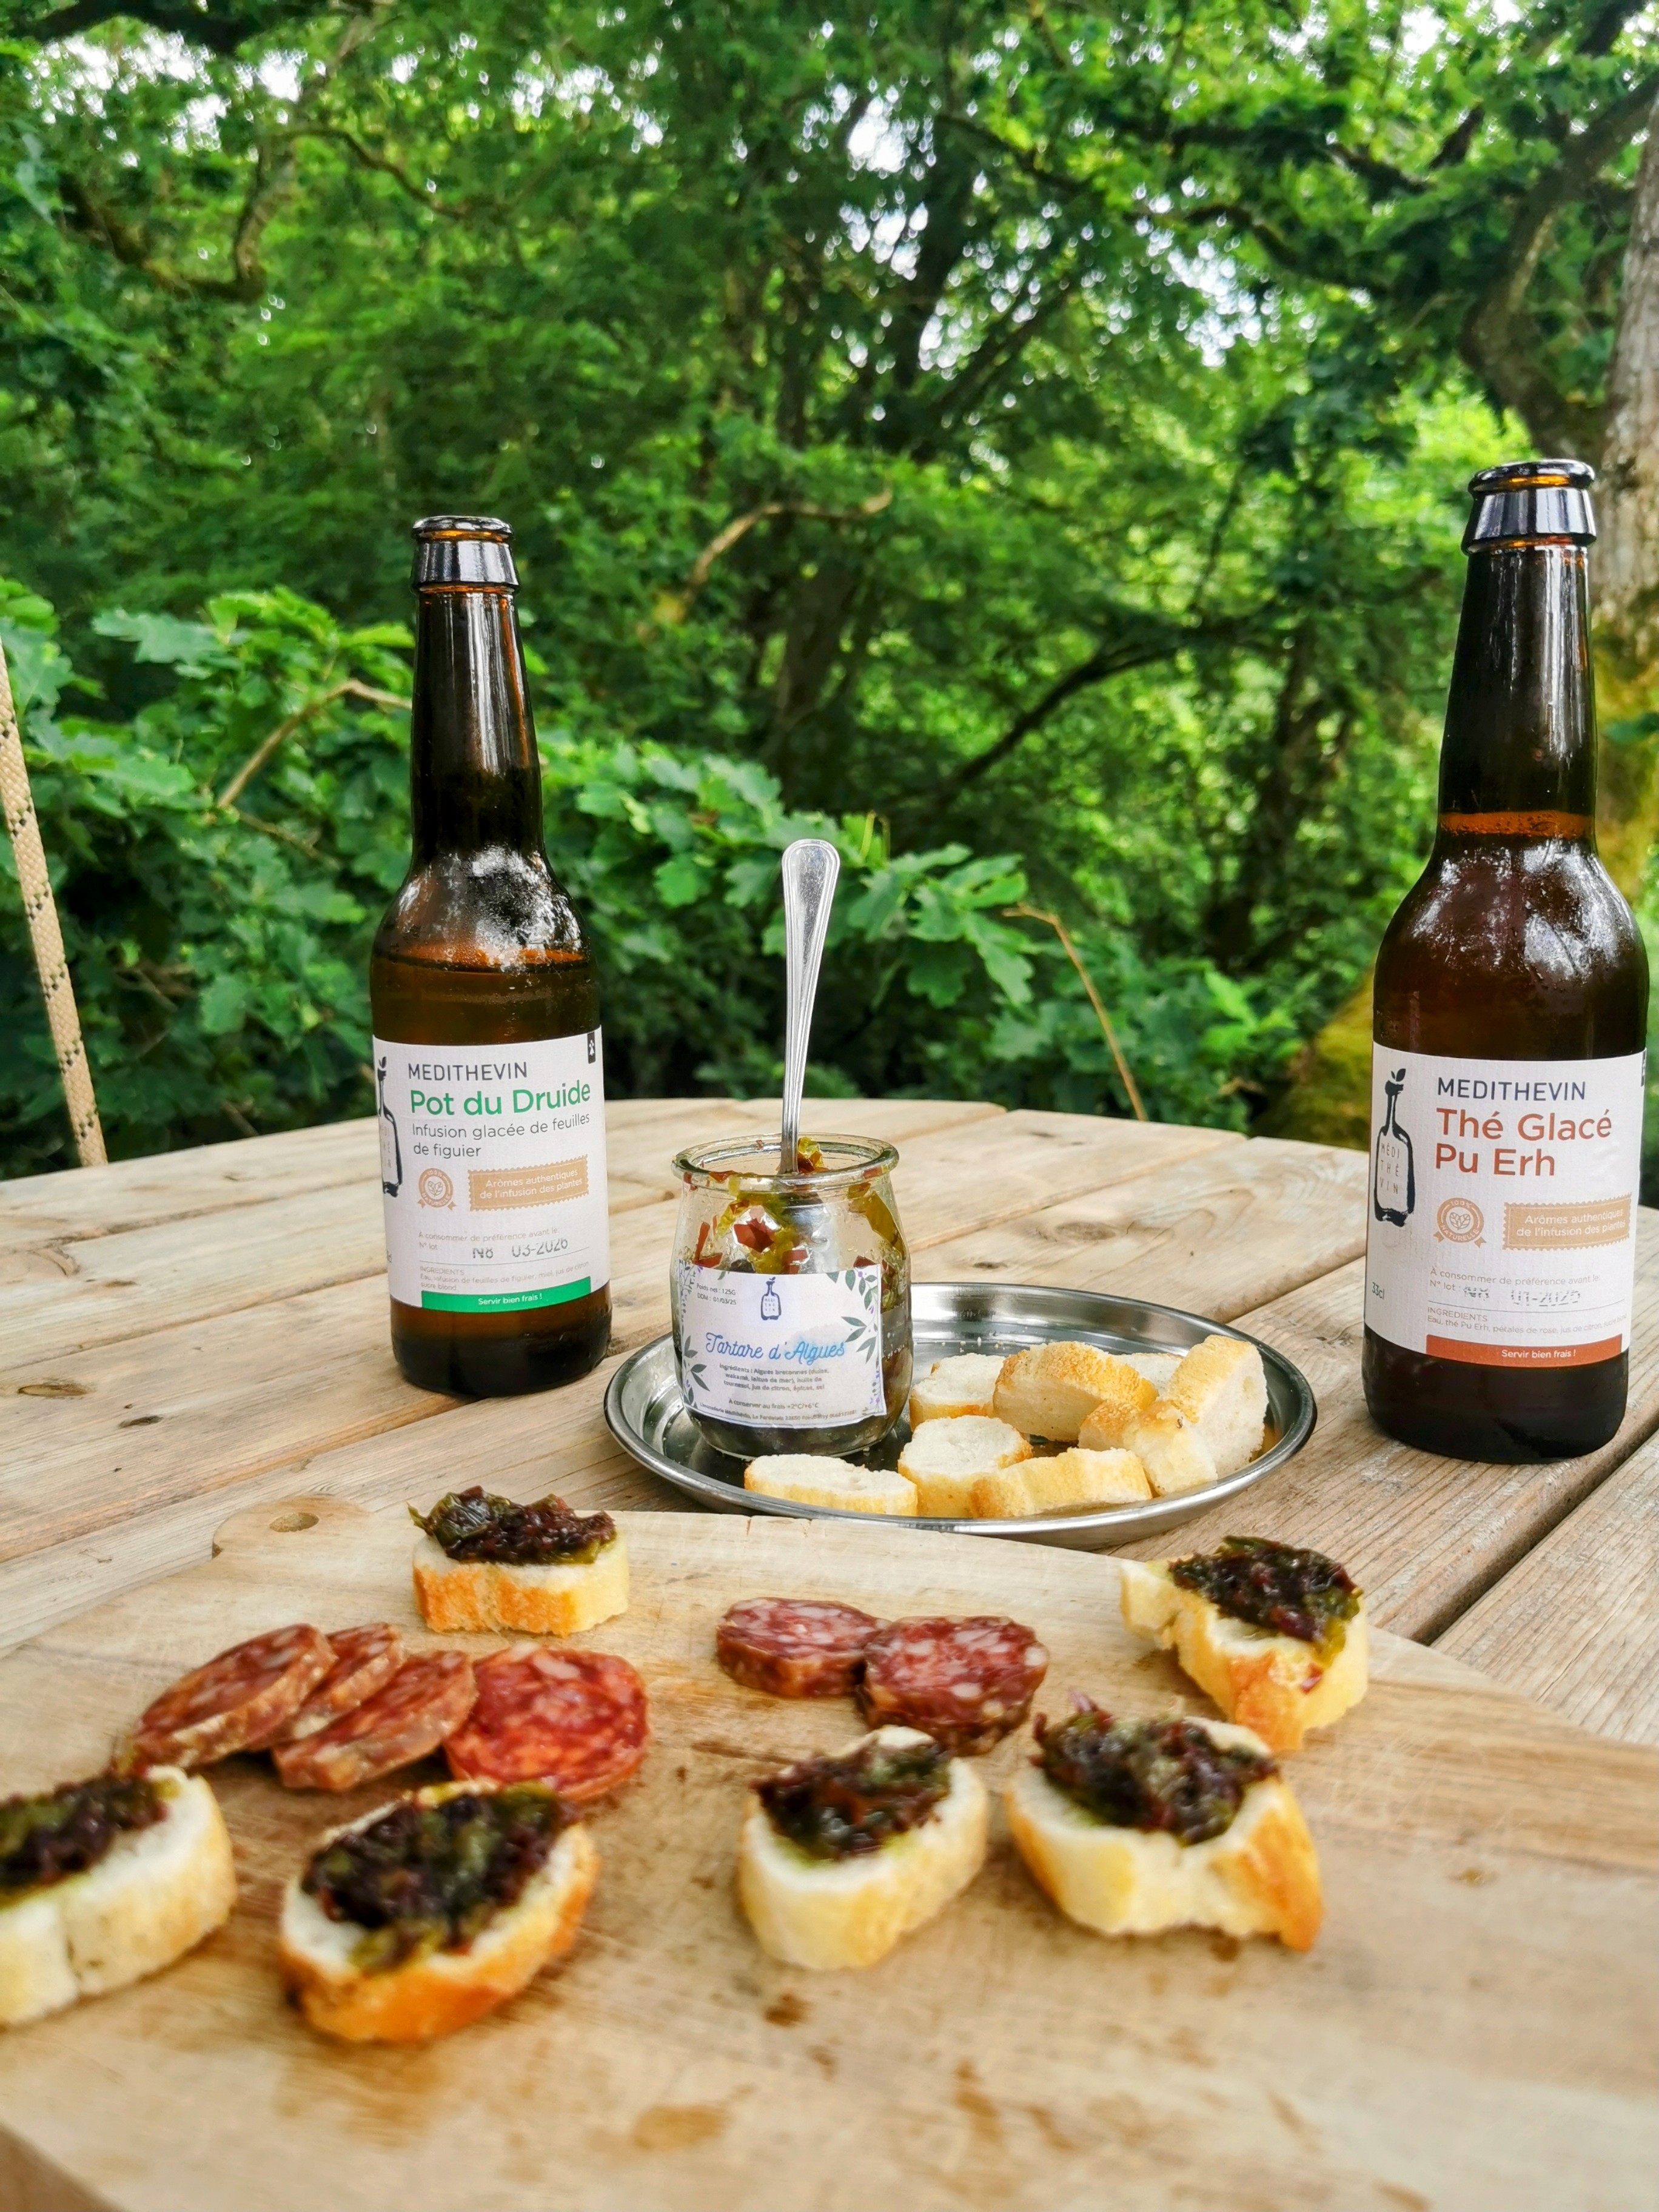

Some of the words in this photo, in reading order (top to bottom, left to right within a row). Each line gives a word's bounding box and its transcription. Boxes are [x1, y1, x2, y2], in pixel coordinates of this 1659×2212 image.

[408, 1062, 527, 1081] MEDITHEVIN
[411, 1090, 455, 1115] Pot
[463, 1091, 502, 1116] du
[513, 1079, 591, 1113] Druide
[1438, 1077, 1586, 1101] MEDITHEVIN
[412, 1123, 467, 1138] Infusion
[472, 1124, 525, 1141] glacée
[530, 1121, 548, 1134] de
[552, 1113, 590, 1131] feuilles
[1436, 1107, 1504, 1140] Thé
[1517, 1108, 1612, 1141] Glacé
[414, 1142, 429, 1155] de
[433, 1143, 481, 1159] figuier
[1435, 1142, 1478, 1173] Pu
[1493, 1148, 1555, 1176] Erh
[486, 1179, 523, 1188] Arômes
[526, 1169, 578, 1184] authentiques
[480, 1190, 492, 1199] de
[495, 1187, 537, 1198] l'infusion
[540, 1185, 554, 1193] des
[557, 1178, 583, 1192] plantes
[1450, 1200, 1473, 1208] 100%
[1524, 1214, 1569, 1225] Arômes
[1570, 1208, 1624, 1224] authentiques
[483, 1233, 526, 1242] préférence
[529, 1228, 550, 1238] avant
[1440, 1224, 1480, 1242] NATURELLE
[1516, 1227, 1532, 1237] de
[1535, 1225, 1582, 1237] l'infusion
[1584, 1223, 1600, 1235] des
[1601, 1219, 1626, 1233] plantes
[420, 1265, 465, 1275] INGREDIENTS
[511, 1273, 537, 1282] figuier,
[1430, 1266, 1437, 1276] À
[1439, 1271, 1496, 1284] consommer
[1499, 1276, 1512, 1285] de
[1515, 1276, 1566, 1286] préférence
[1567, 1276, 1590, 1284] avant
[696, 1282, 709, 1292] Poids
[1372, 1282, 1385, 1299] 33cl
[1443, 1282, 1456, 1291] lot
[697, 1292, 709, 1301] DDM
[712, 1296, 737, 1305] 01/03/25
[1427, 1307, 1488, 1322] INGREDIENTS
[1427, 1316, 1443, 1326] Eau,
[1474, 1322, 1490, 1332] Erh,
[1493, 1324, 1523, 1333] pétales
[706, 1332, 763, 1359] Tartare
[1501, 1349, 1529, 1358] Servir
[1531, 1350, 1552, 1358] bien
[1553, 1349, 1572, 1358] frais
[719, 1362, 749, 1373] Ingrédients
